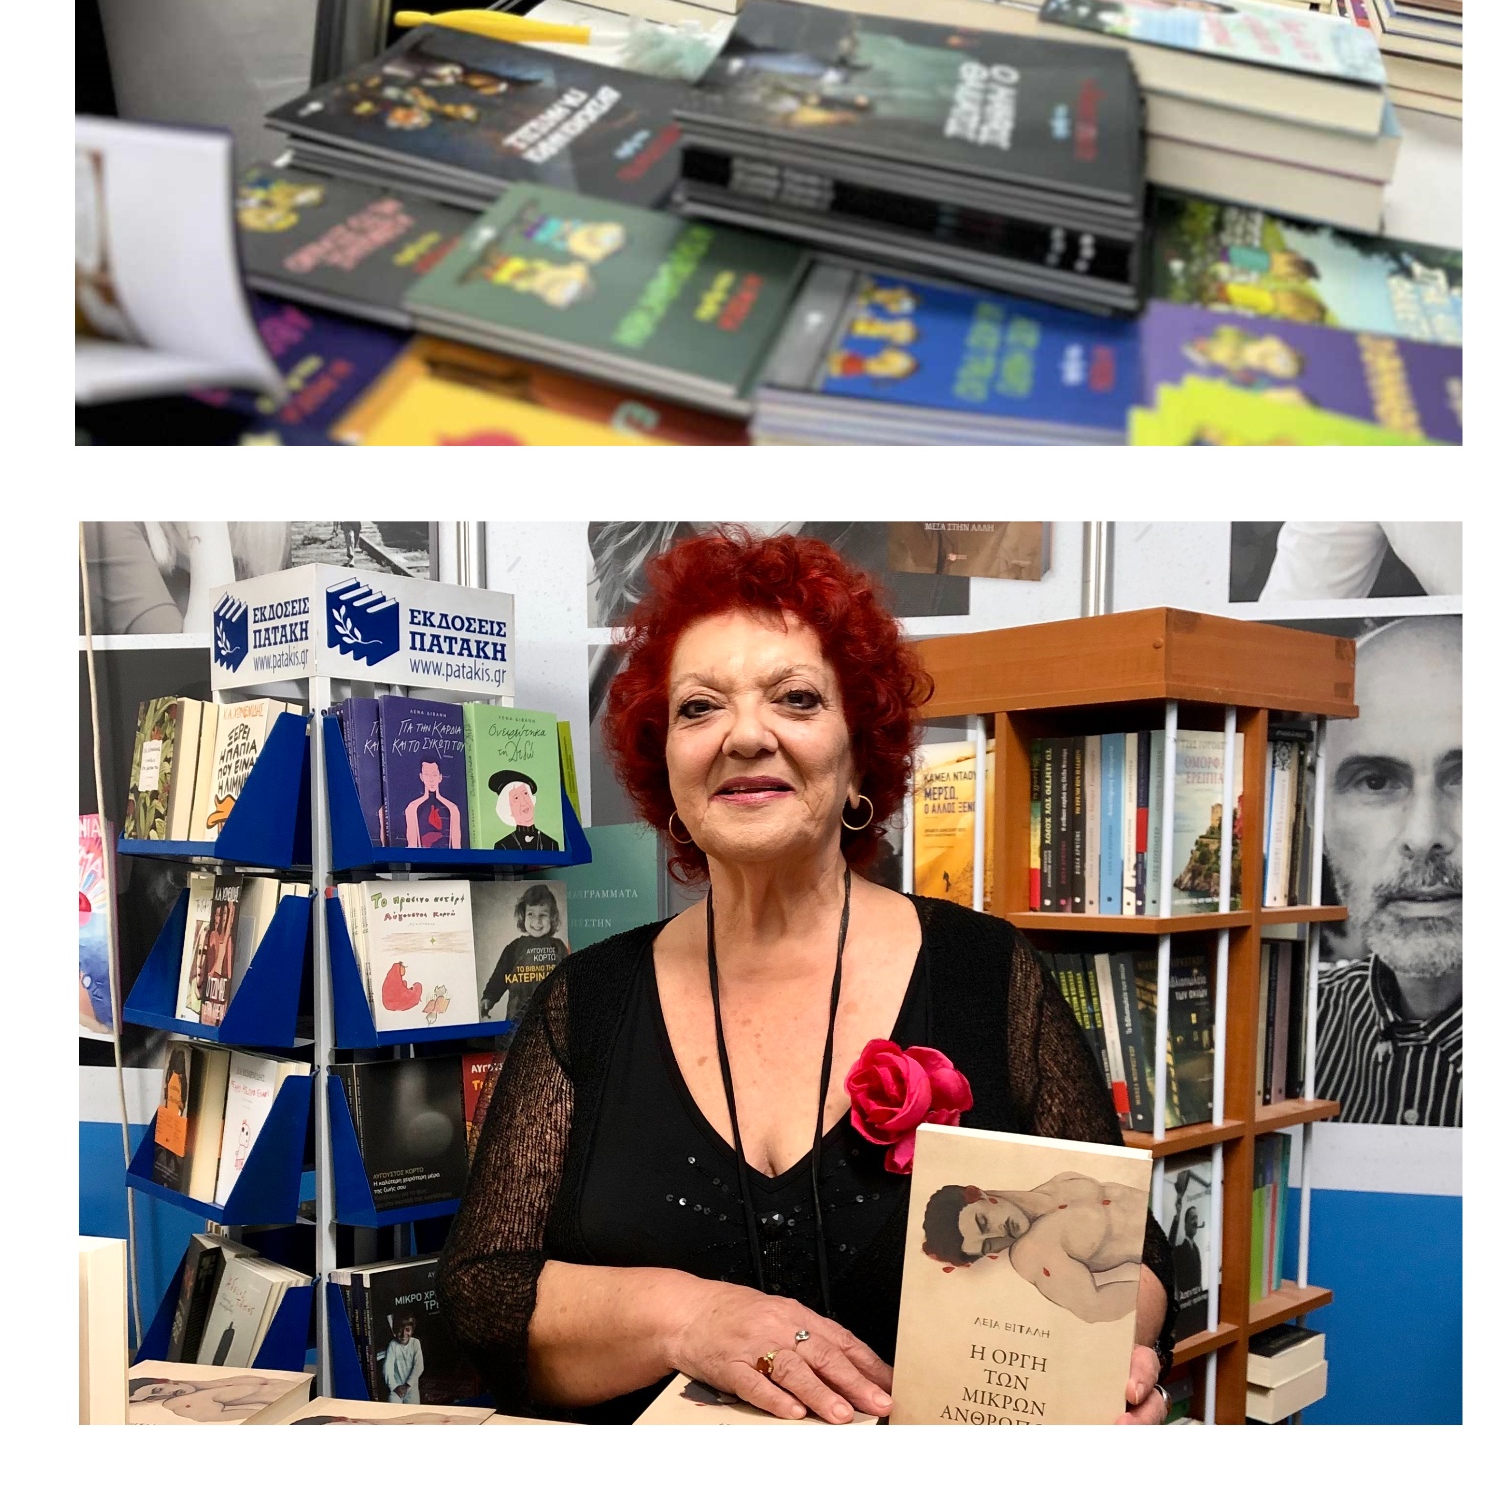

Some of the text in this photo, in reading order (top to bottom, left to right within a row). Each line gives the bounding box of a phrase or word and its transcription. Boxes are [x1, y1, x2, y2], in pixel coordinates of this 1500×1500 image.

[253, 596, 310, 624] ΕΚΔΟΣΕΙΣ
[253, 620, 310, 649] ΠΑΤΑΚΗ
[409, 608, 507, 638] ΕΚΔΟΣΕΙΣ
[409, 631, 507, 663] ΠΑΤΑΚΗ
[254, 648, 309, 674] www.patakis.gr
[409, 658, 507, 687] www.patakis.gr
[426, 710, 448, 718] ΔΙΒΑΝΗ
[228, 723, 250, 747] ΞΕΡΕΙ
[398, 719, 462, 738] ΓΙΑ ΤΗΝ ΚΑΡΔΙΑ
[226, 739, 258, 762] ΠΑΠΙΑ
[392, 738, 407, 756] ΚΑΙ
[408, 740, 420, 753] ΤΟ
[422, 737, 451, 760] ΣΥΚΩΤΙ
[218, 766, 232, 780] ΠΟΥ
[930, 803, 955, 814] ΑΛΛΟΣ
[371, 892, 430, 912] Το πράσινο
[533, 953, 556, 962] ΚΟΡΤΩ
[394, 1292, 422, 1306] ΜΙΚΡΟ
[974, 1316, 1050, 1338] ΛΕΙΑ ΒΙΤΑΛΗ
[970, 1344, 1048, 1373] Η ΟΡΓΗ
[984, 1368, 1029, 1392] ΤΩΝ
[962, 1387, 1046, 1418] ΜΙΚΡΩΝ
